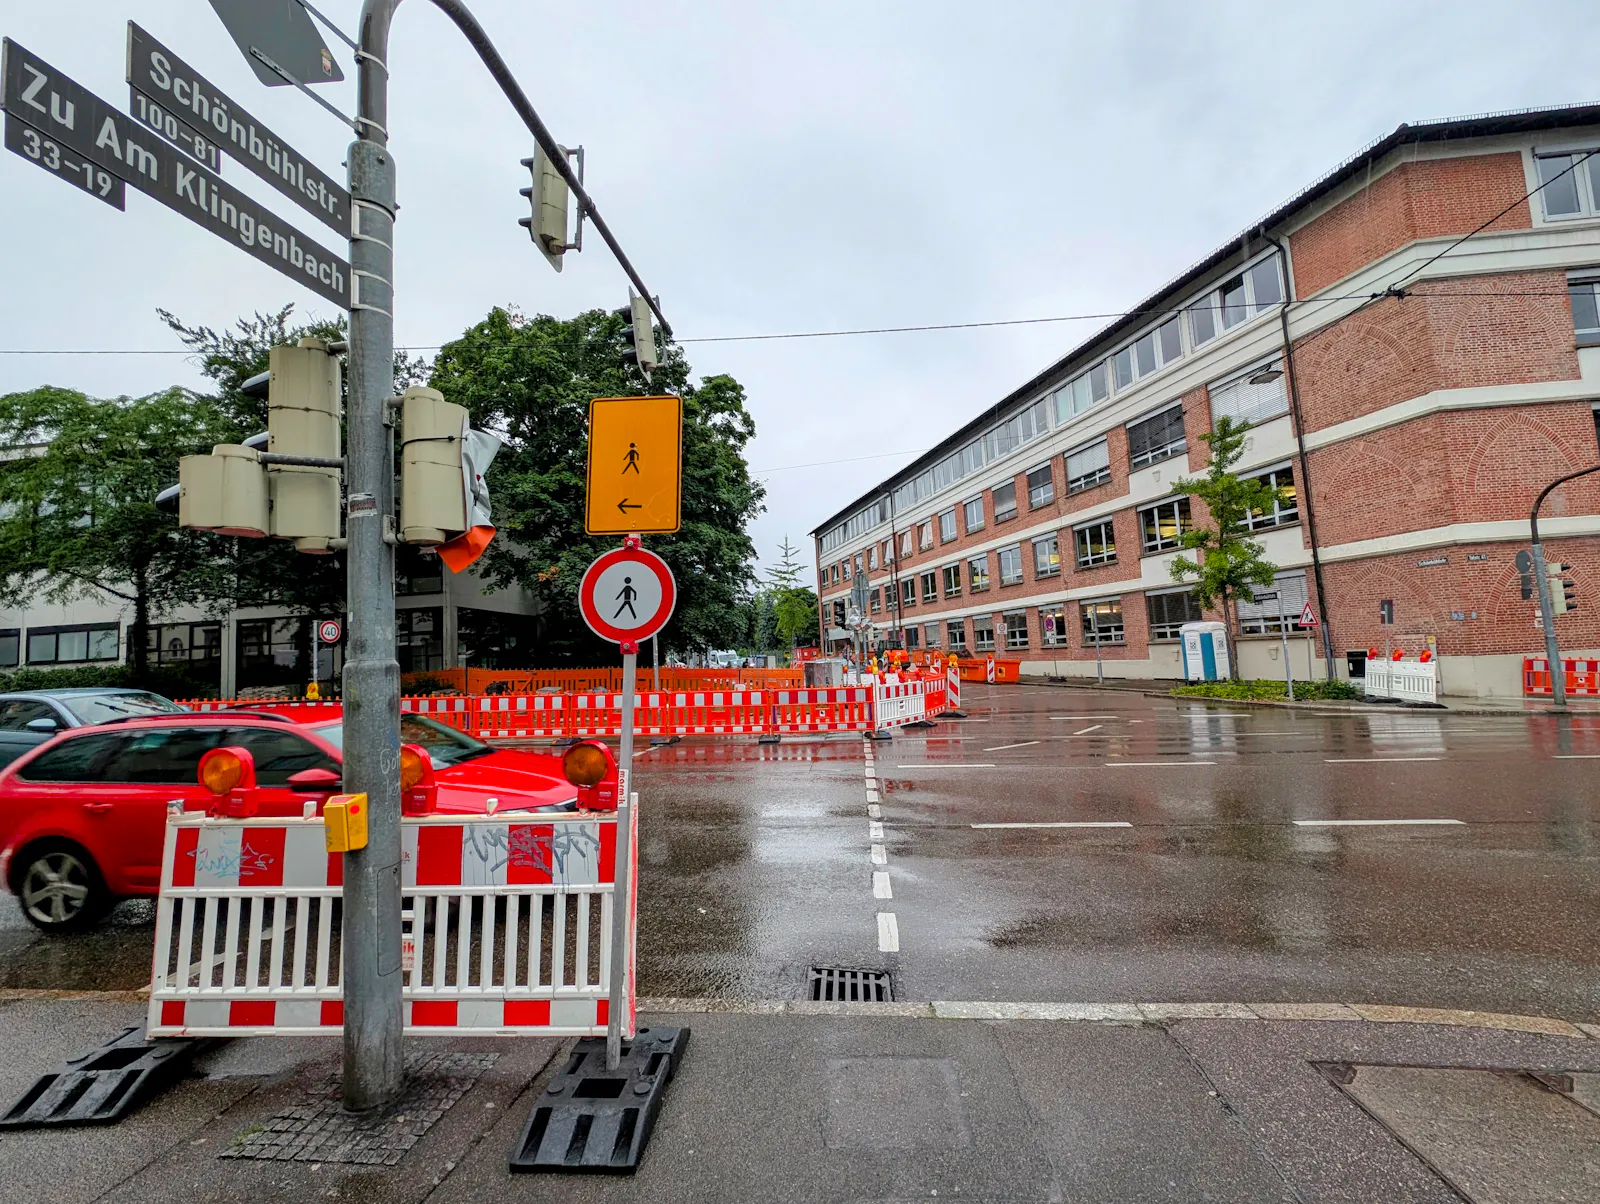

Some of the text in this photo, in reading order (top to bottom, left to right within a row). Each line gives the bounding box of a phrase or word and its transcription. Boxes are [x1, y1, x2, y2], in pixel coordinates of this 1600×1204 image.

[22, 128, 112, 198] 33-19
[136, 95, 219, 170] 100-81
[150, 50, 343, 221] Schönbühlstr.
[21, 62, 344, 294] Zu Am Klingenbach
[324, 626, 337, 637] 40
